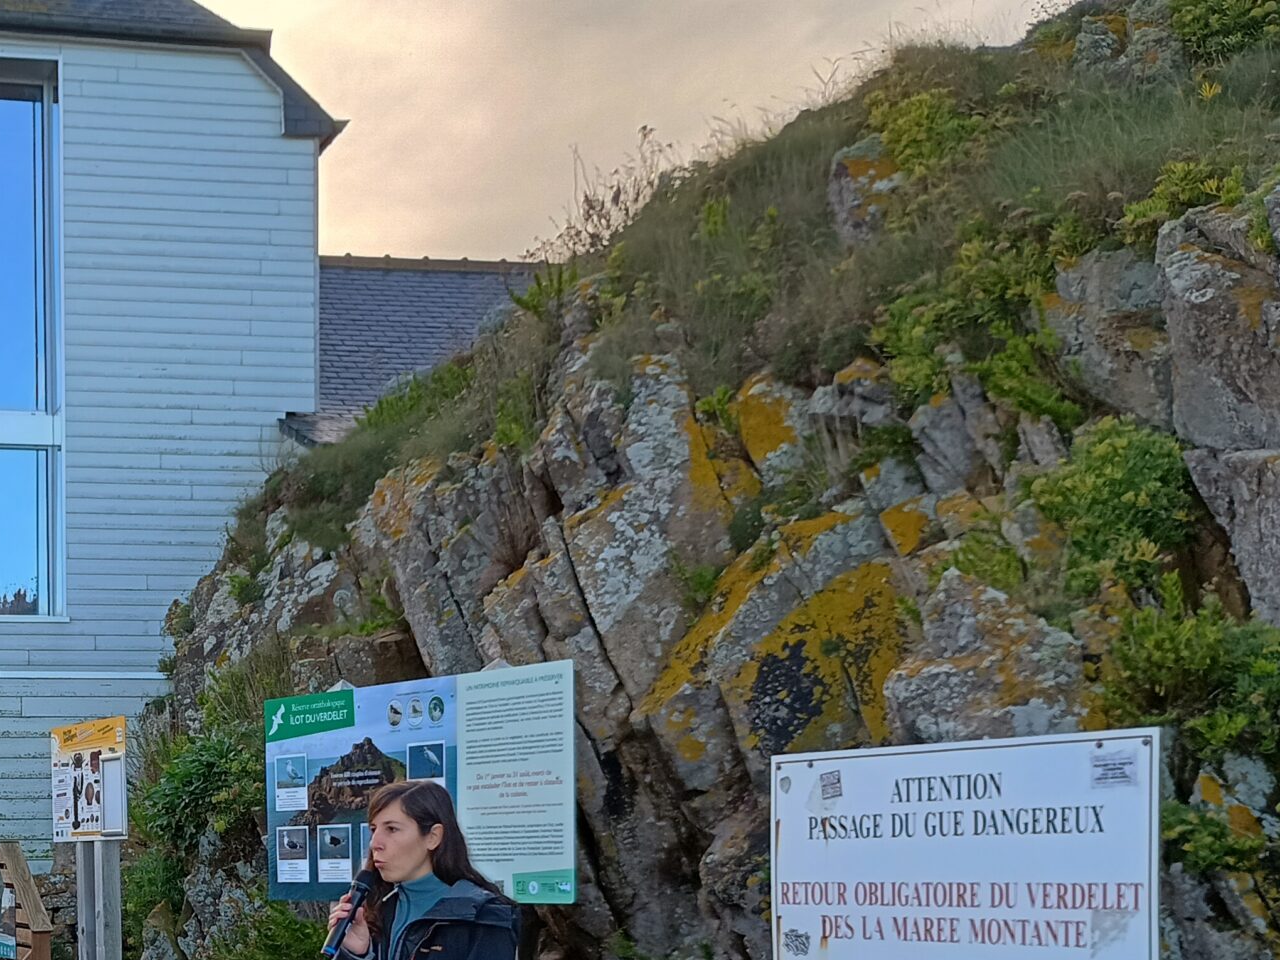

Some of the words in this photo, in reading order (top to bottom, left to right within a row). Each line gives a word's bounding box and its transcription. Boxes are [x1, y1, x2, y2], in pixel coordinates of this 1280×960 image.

[305, 713, 315, 724] DU
[315, 709, 348, 722] VERDELET
[890, 772, 1002, 803] ATTENTION
[808, 814, 883, 840] PASSAGE
[891, 812, 917, 838] DU
[924, 810, 965, 837] GUE
[972, 805, 1104, 836] DANGEREUX
[781, 881, 847, 906] RETOUR
[854, 881, 981, 908] OBLIGATOIRE
[989, 882, 1018, 909] DU
[1026, 882, 1144, 912] VERDELET
[821, 914, 855, 940] DES
[861, 915, 885, 941] LA
[891, 916, 961, 943] MAREE
[968, 918, 1088, 948] MONTANTE
